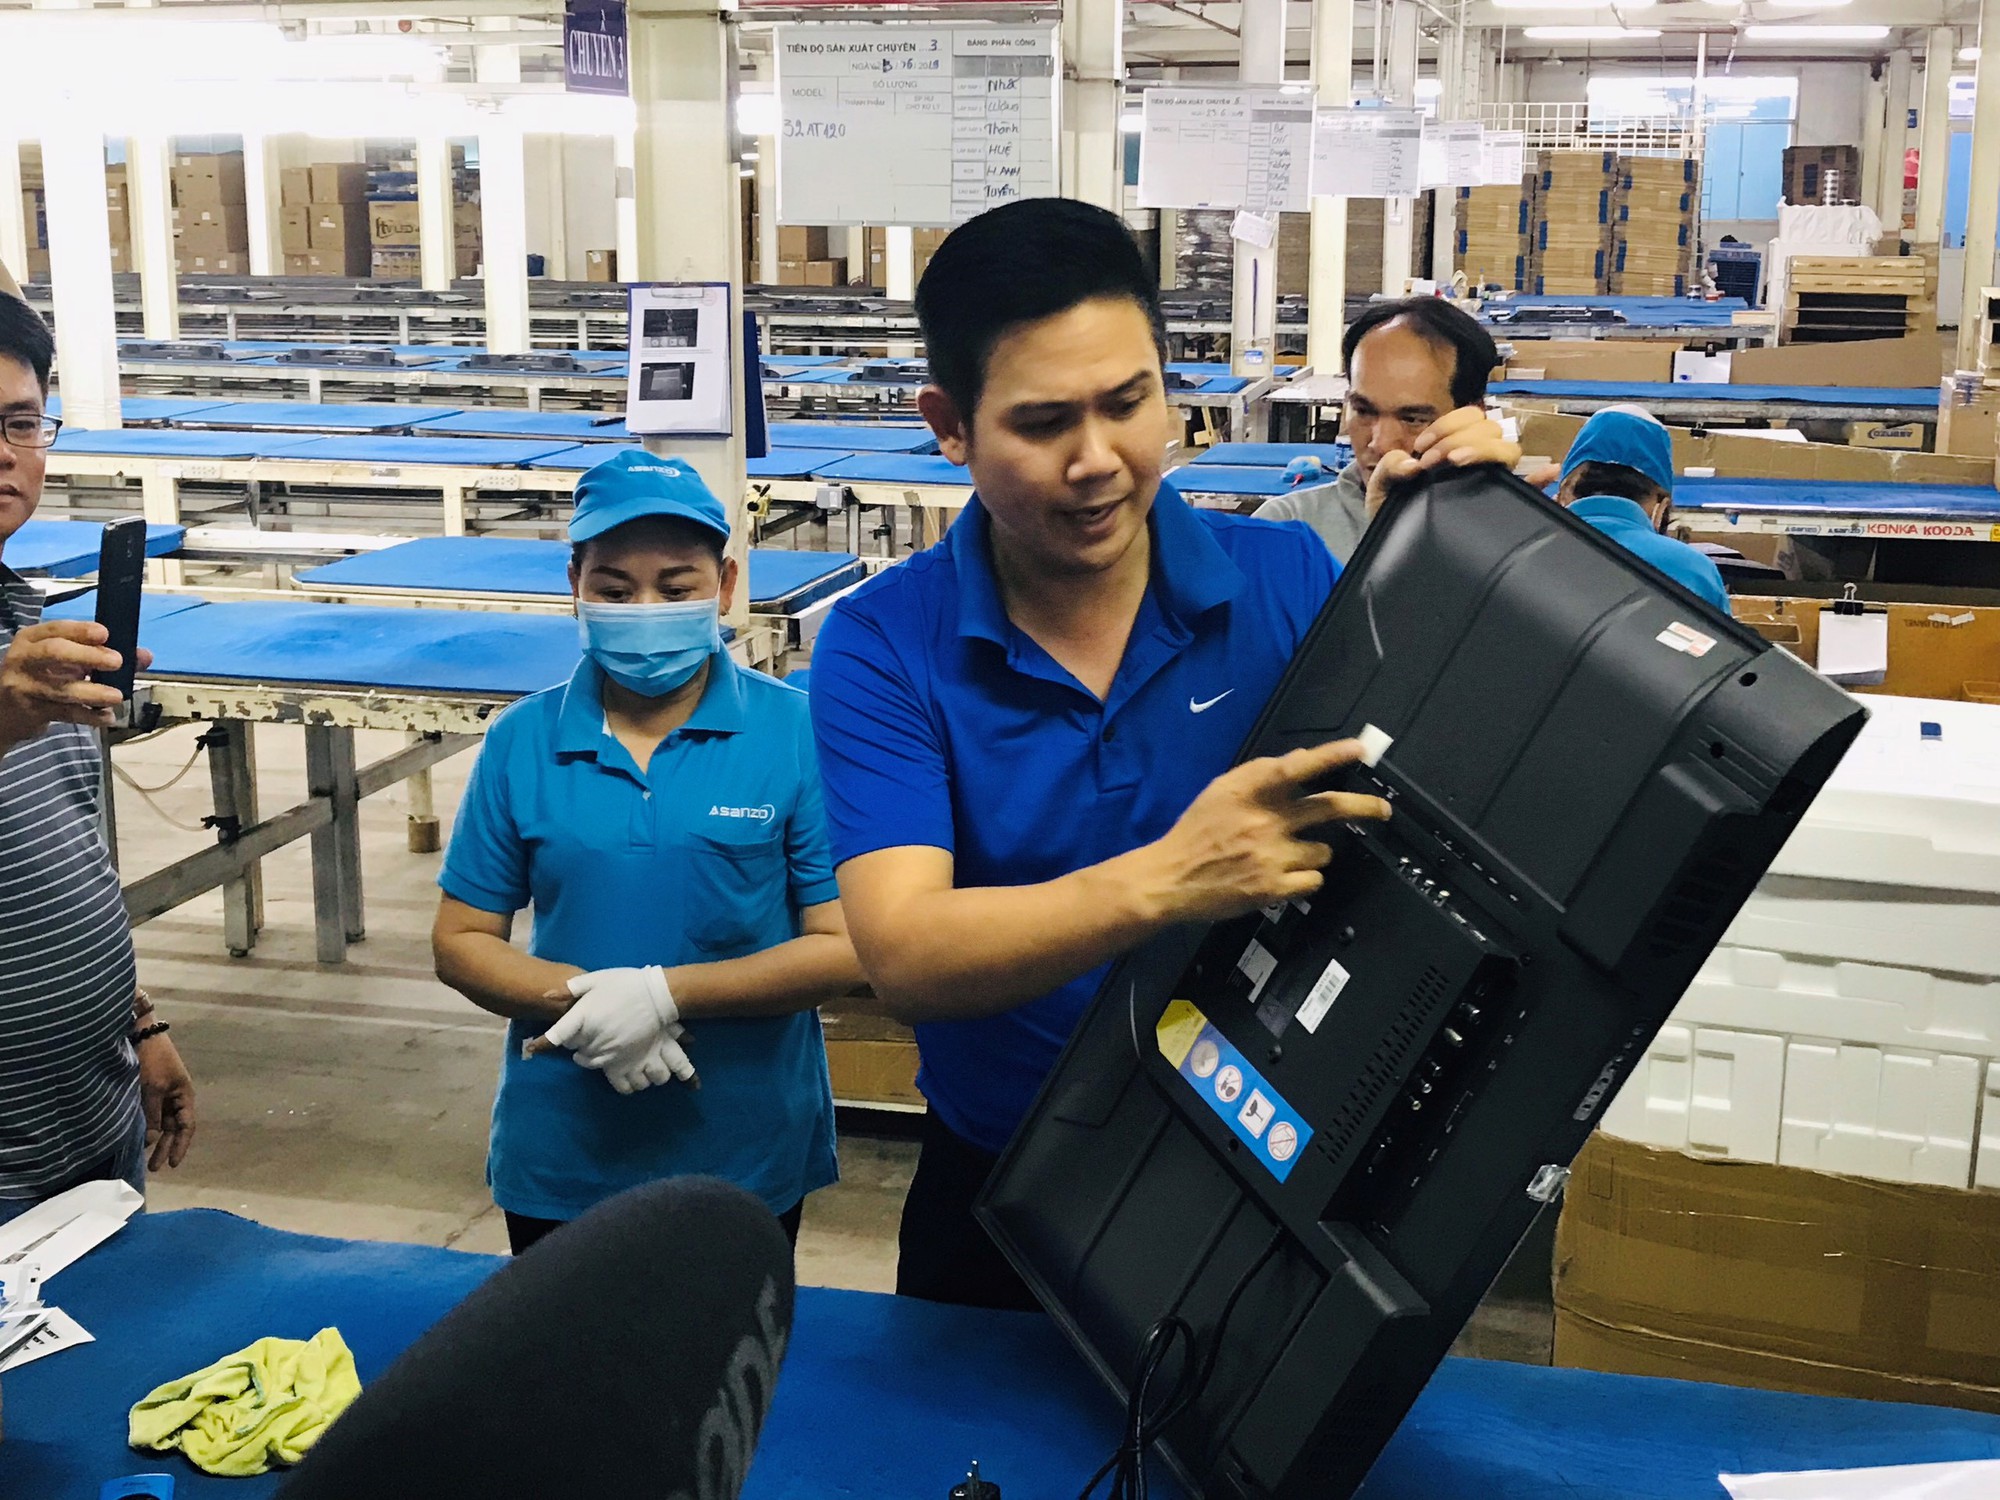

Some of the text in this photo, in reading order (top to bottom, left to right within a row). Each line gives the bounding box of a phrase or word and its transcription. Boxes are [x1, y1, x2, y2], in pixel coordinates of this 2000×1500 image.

[930, 39, 938, 52] 3
[617, 36, 624, 79] 3
[791, 88, 823, 97] MODEL
[627, 465, 681, 477] Asanzo
[1867, 523, 1918, 535] KONKA
[709, 804, 775, 822] Asanzo
